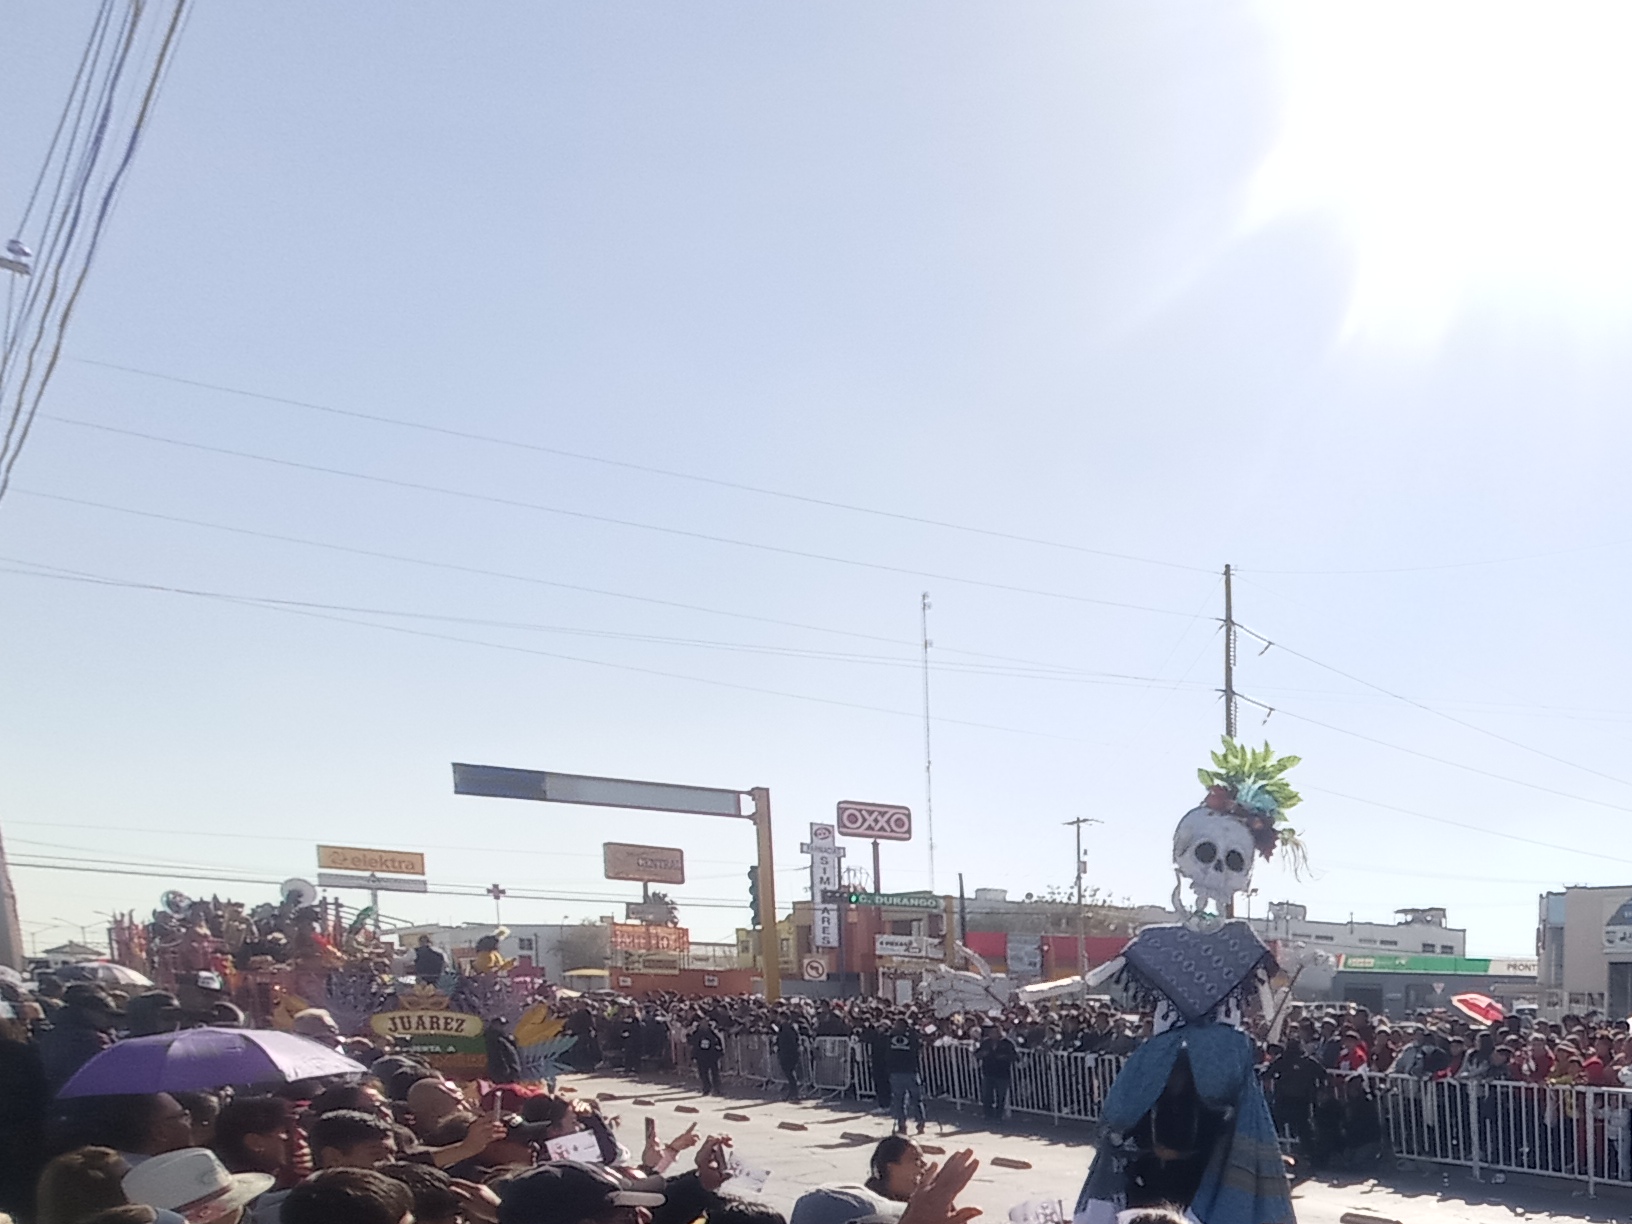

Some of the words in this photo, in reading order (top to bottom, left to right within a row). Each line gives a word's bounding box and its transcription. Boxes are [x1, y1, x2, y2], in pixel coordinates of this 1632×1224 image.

[842, 808, 910, 833] OXXO
[351, 853, 415, 872] elektra
[637, 857, 681, 872] CENTRAL
[819, 856, 831, 945] SIMARES
[875, 896, 937, 908] DURANGO
